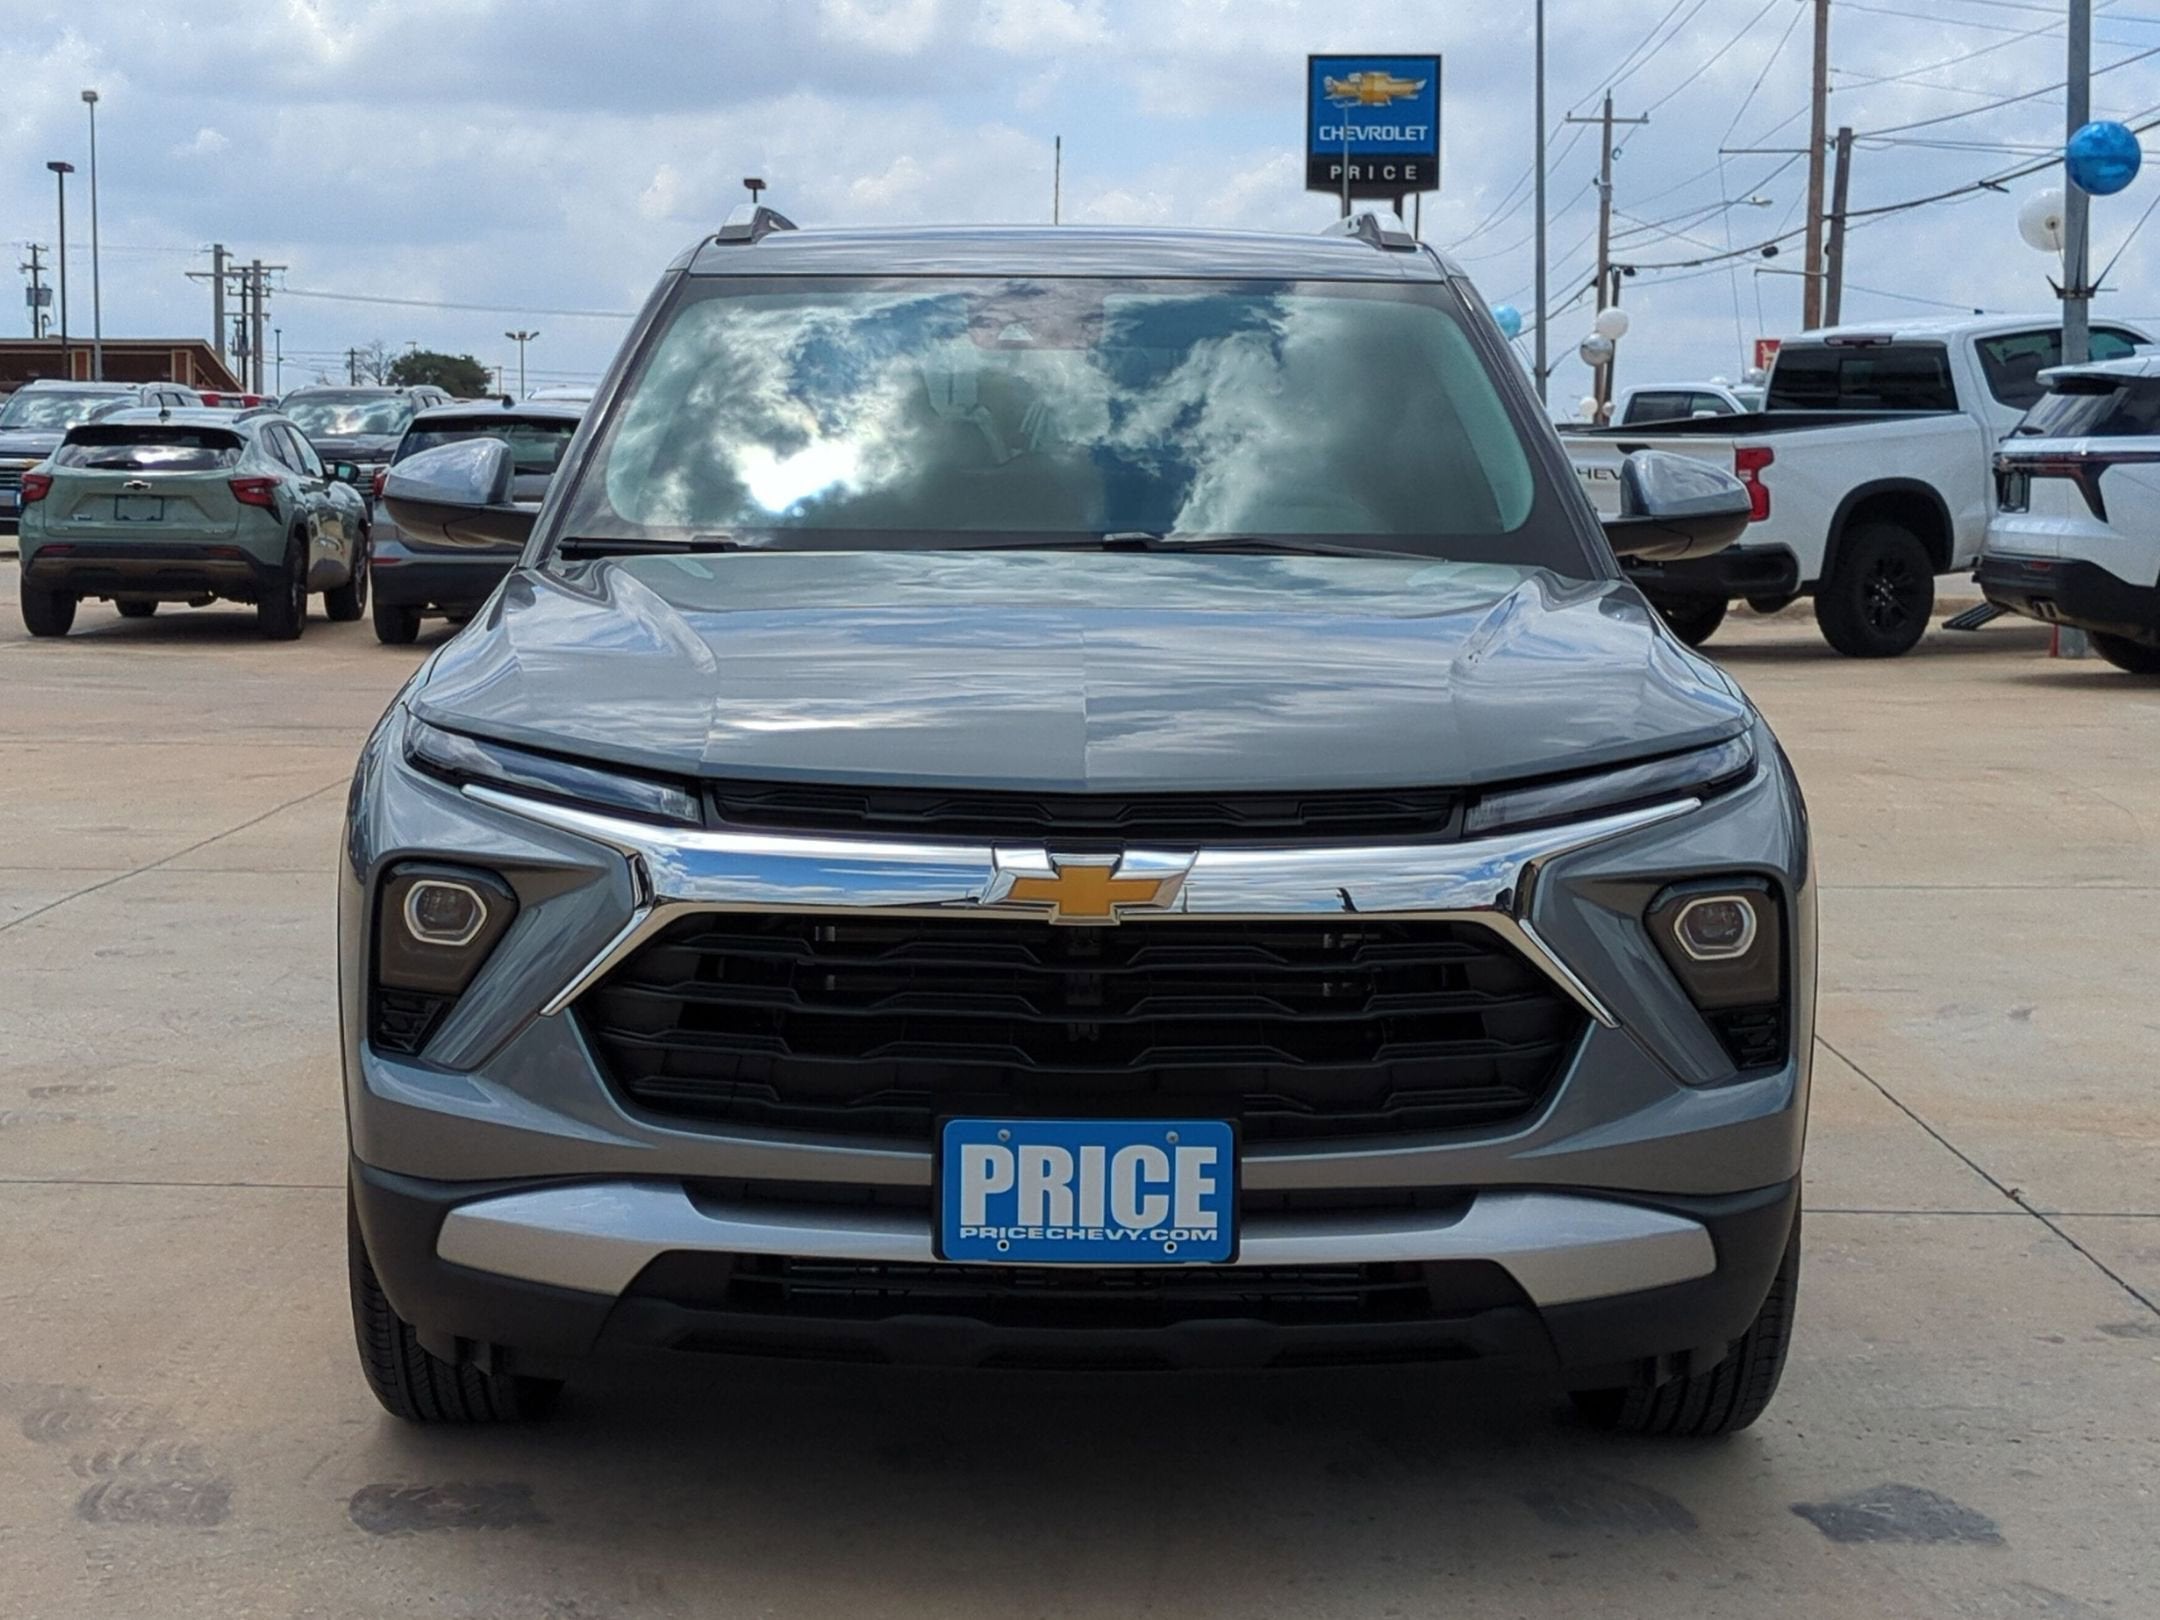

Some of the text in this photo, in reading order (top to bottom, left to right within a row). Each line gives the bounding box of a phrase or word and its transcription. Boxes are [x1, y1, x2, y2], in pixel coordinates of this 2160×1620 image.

[1320, 126, 1428, 141] CHEVROLET
[1330, 165, 1417, 180] PRICE
[1576, 467, 1621, 481] HEV
[960, 1144, 1218, 1229] PRICE
[959, 1226, 1218, 1241] PRICECHEVY.COM
